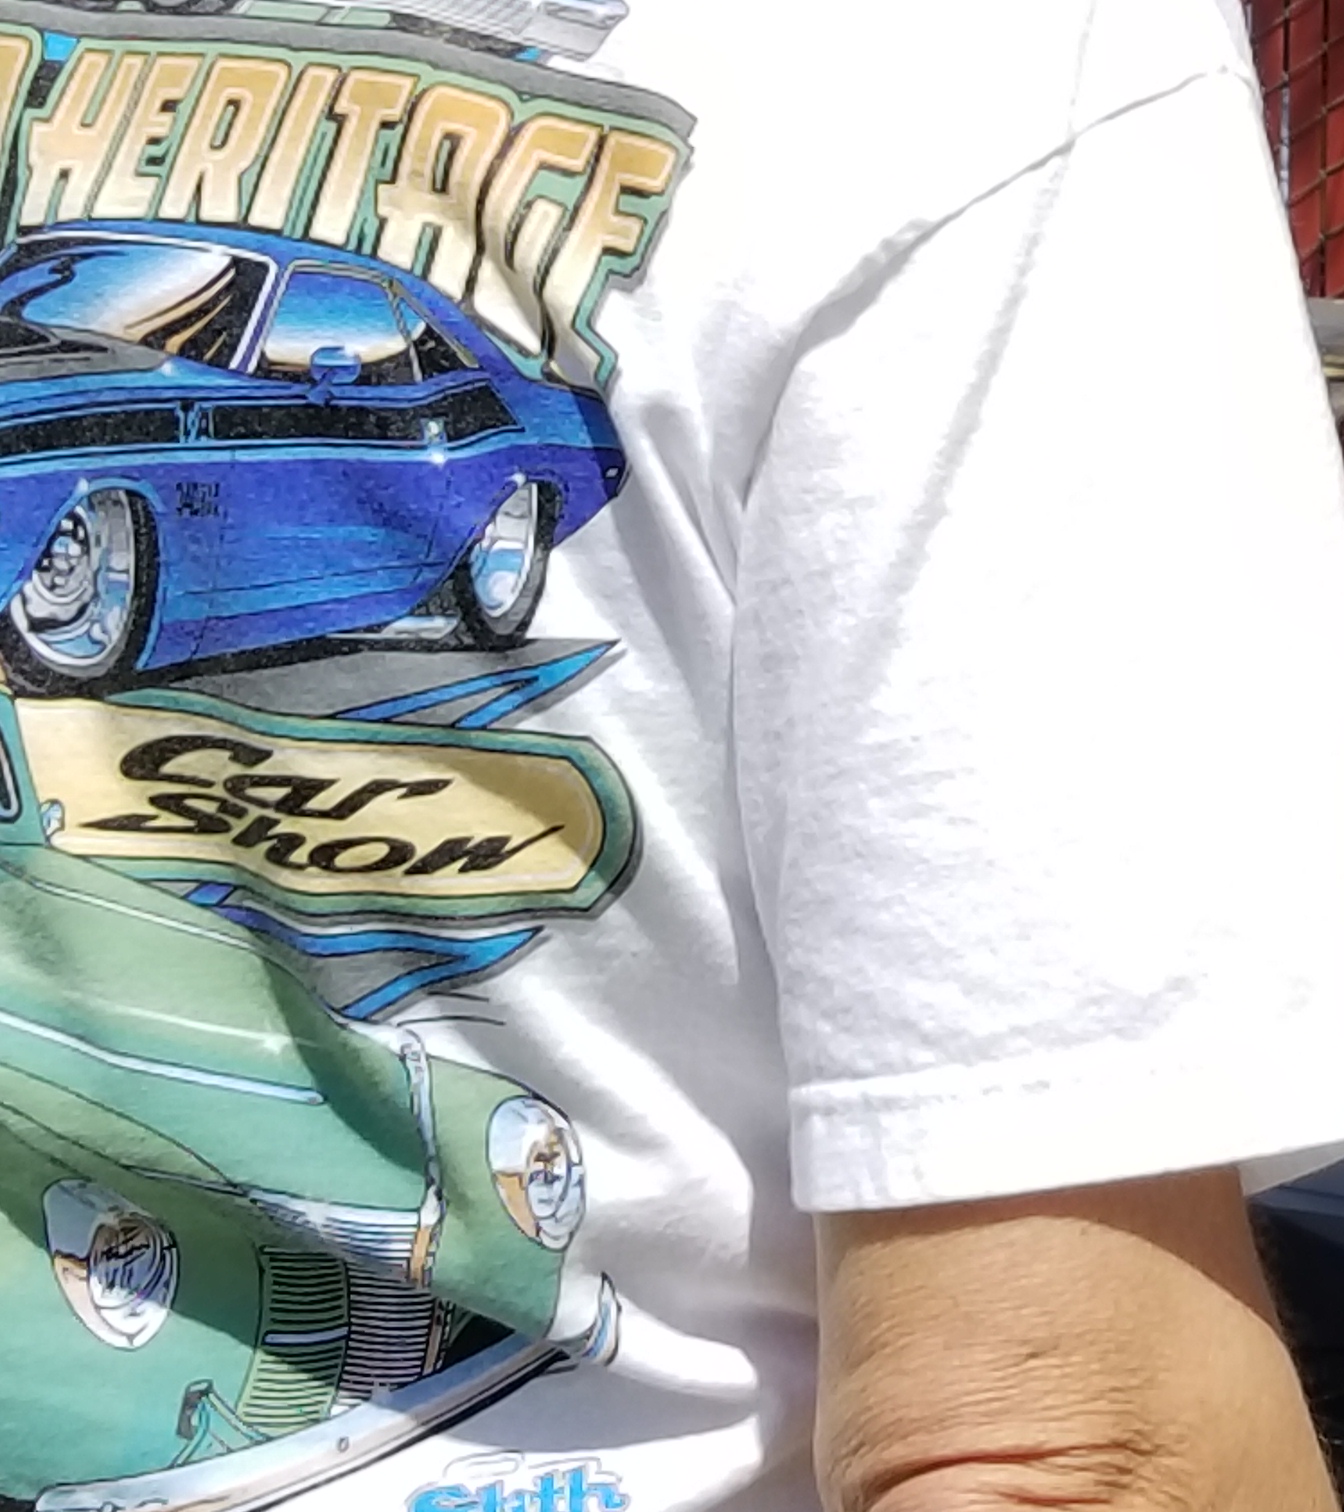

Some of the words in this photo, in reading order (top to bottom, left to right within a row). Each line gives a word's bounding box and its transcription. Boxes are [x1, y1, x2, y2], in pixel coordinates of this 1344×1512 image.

[19, 50, 680, 393] HERITAGE
[119, 734, 454, 820] Car
[79, 793, 565, 875] Show
